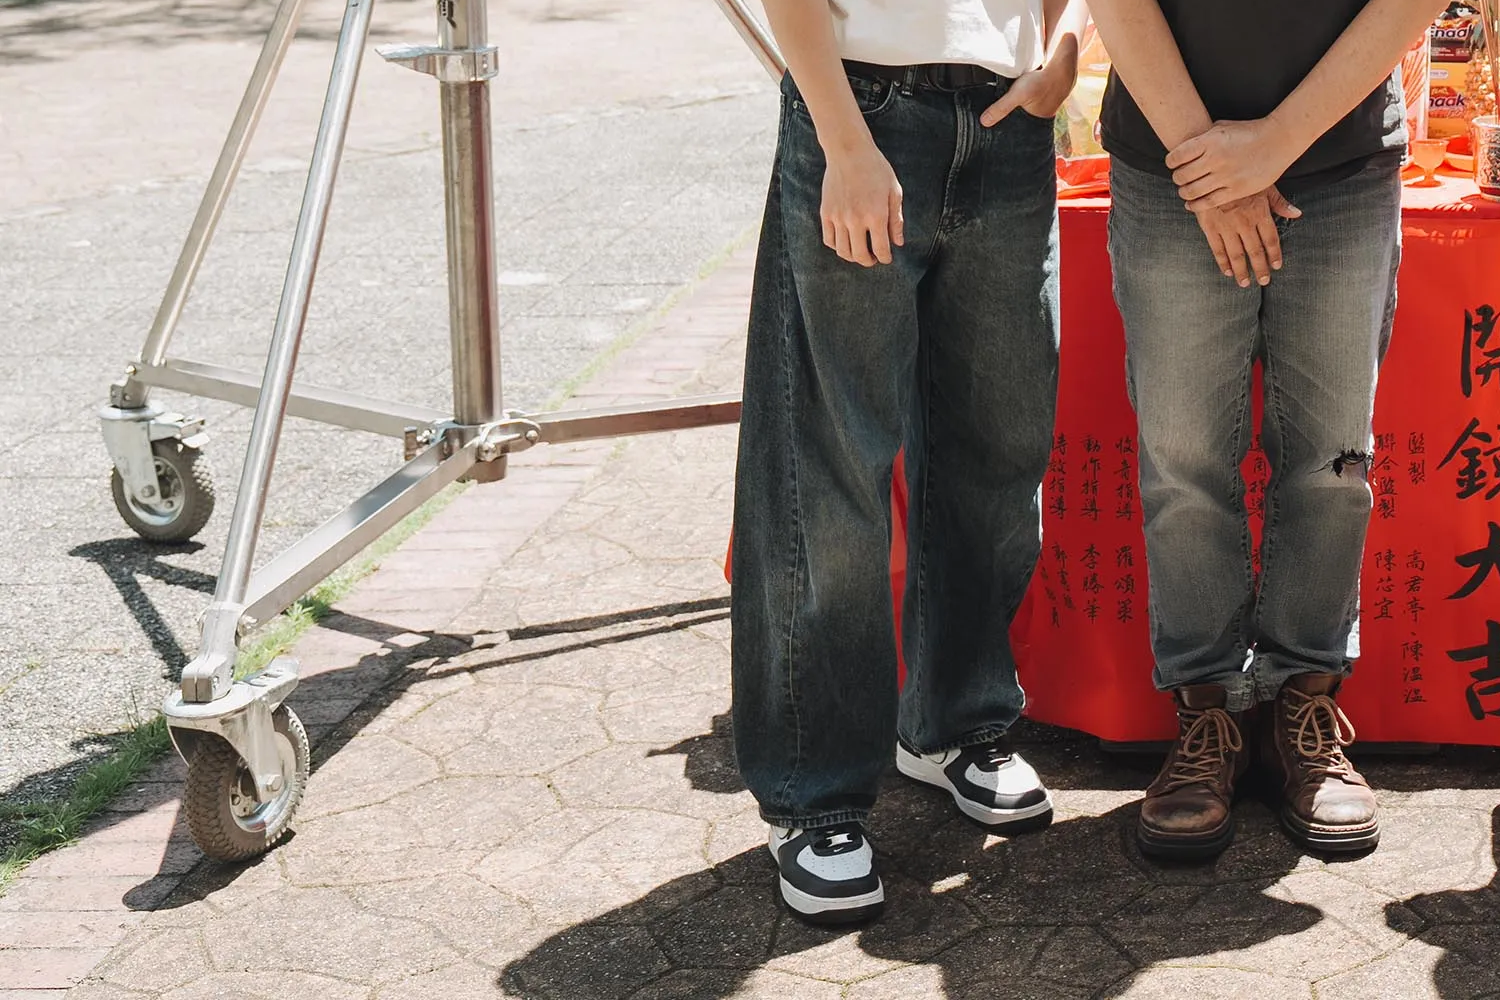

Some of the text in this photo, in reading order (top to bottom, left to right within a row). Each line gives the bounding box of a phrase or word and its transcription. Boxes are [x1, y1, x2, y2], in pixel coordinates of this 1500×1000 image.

[1080, 434, 1103, 522] 動作指導
[1113, 436, 1137, 522] 收音指導
[1374, 433, 1399, 520] 聯合監製
[1407, 431, 1426, 486] 監製
